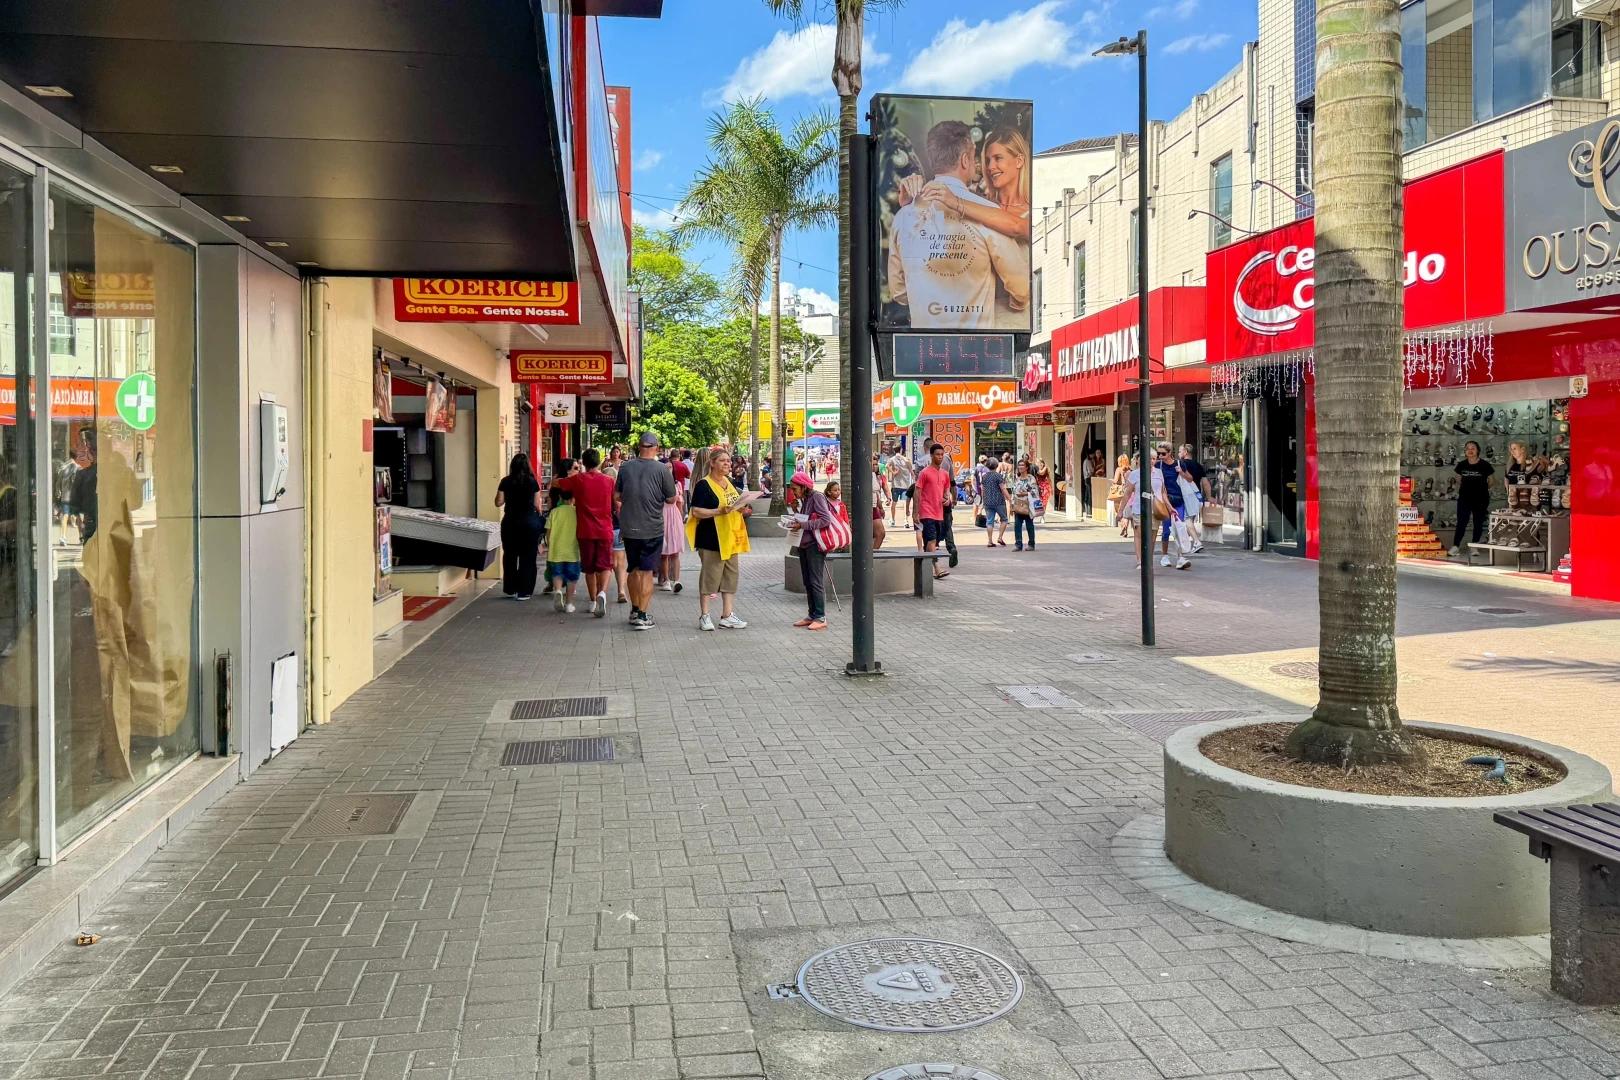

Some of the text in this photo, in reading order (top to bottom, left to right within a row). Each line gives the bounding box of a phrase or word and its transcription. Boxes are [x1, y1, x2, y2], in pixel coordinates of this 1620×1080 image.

[938, 232, 966, 243] magia
[929, 241, 965, 250] de estar
[928, 251, 968, 261] presente
[417, 279, 556, 297] KOERICH
[405, 304, 569, 316] Gente Boa. Gente Nossa.
[944, 305, 984, 313] GUZZATTI
[523, 359, 601, 370] KOERICH
[937, 390, 980, 405] FARMÁCIA
[935, 423, 961, 433] DES
[935, 433, 964, 443] CON
[943, 444, 961, 454] OS
